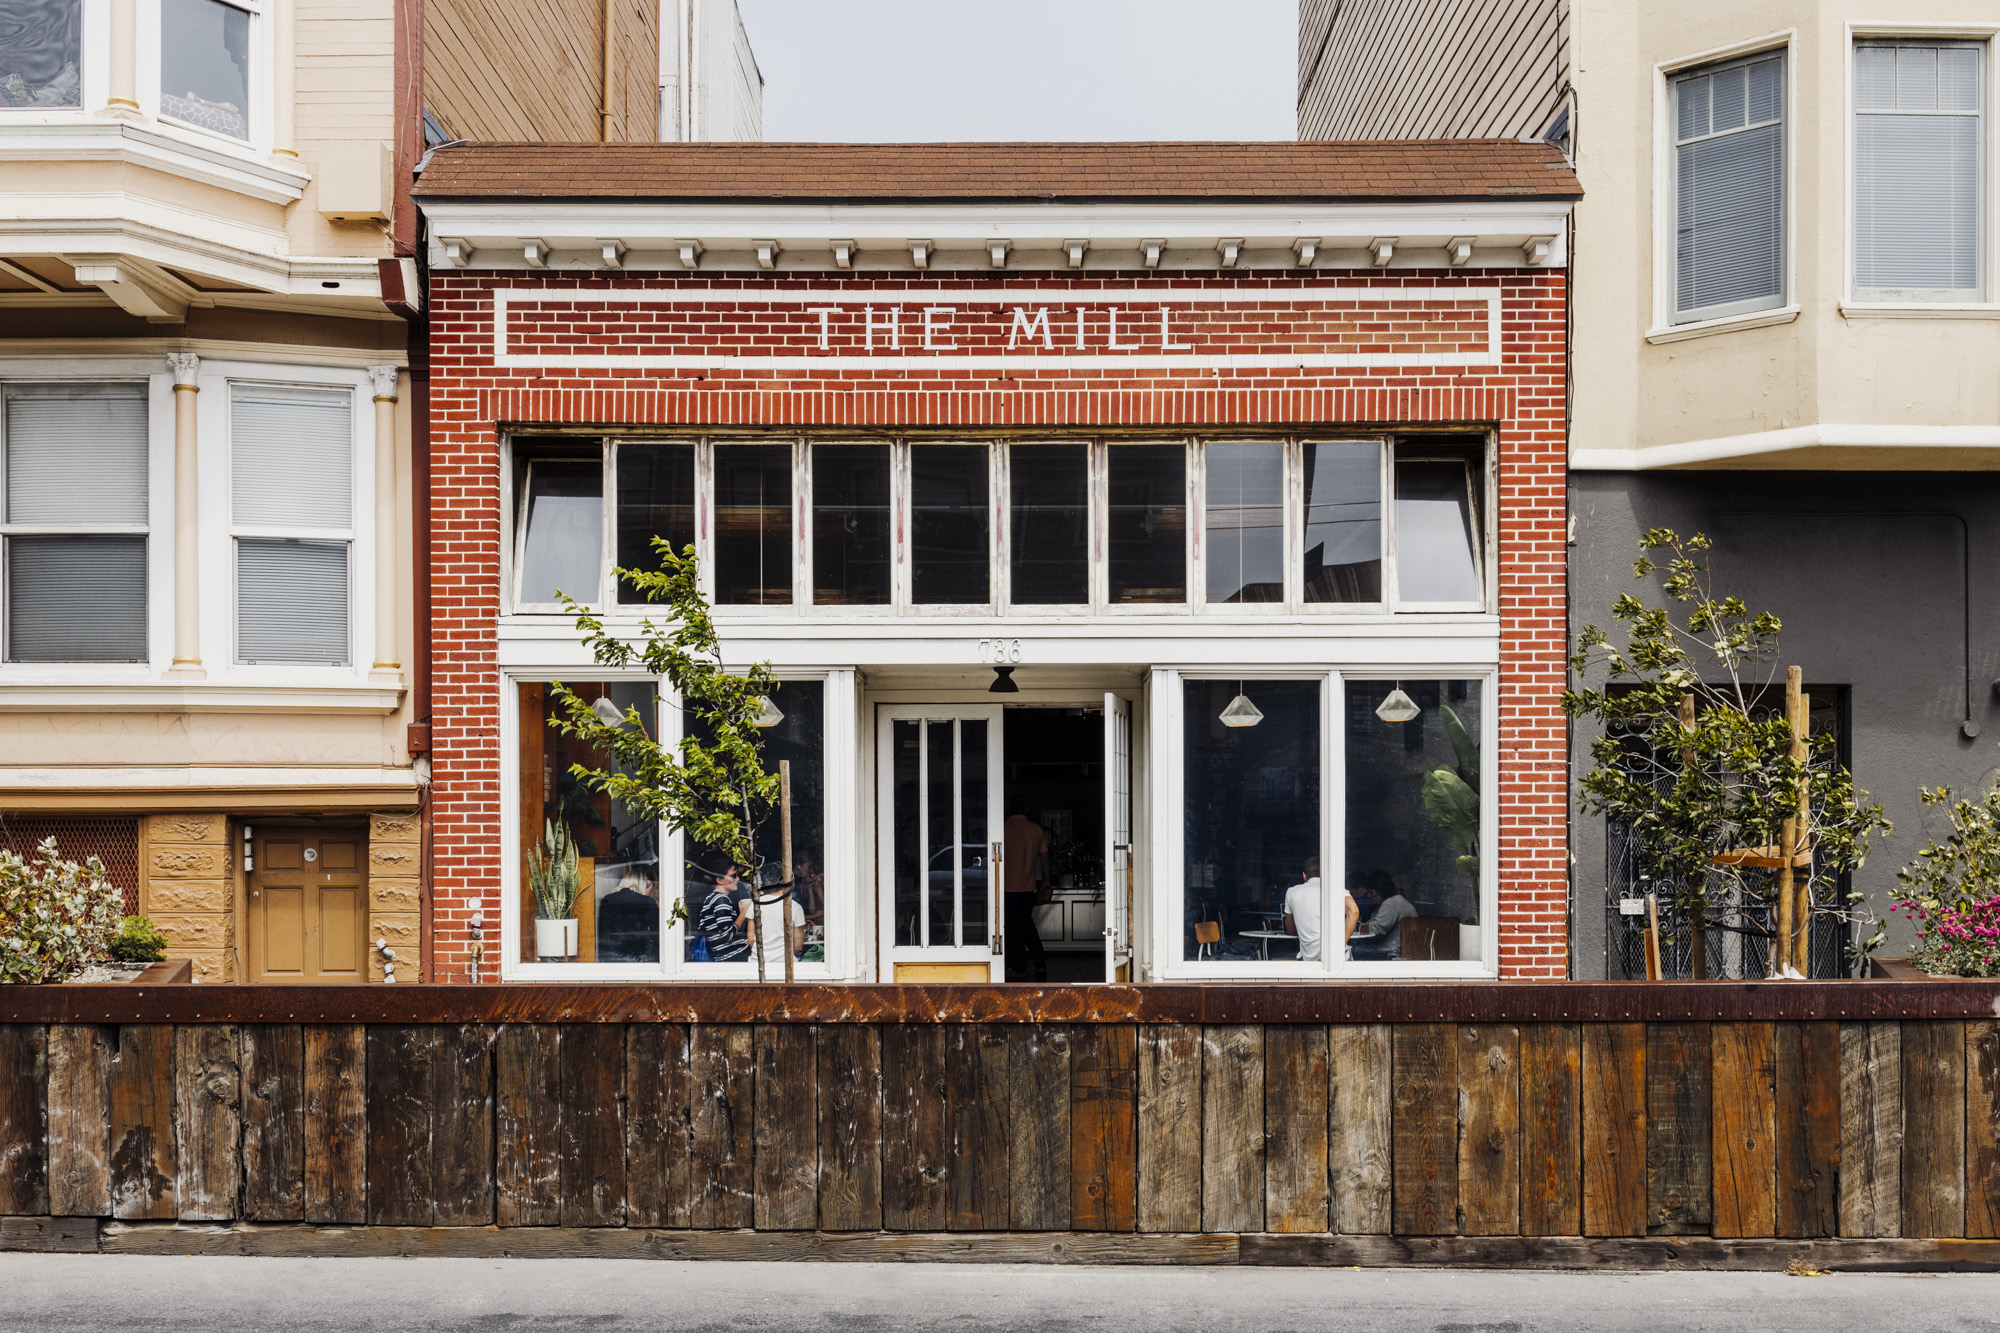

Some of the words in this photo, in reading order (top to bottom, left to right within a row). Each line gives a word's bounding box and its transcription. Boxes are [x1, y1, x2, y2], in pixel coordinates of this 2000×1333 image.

[807, 307, 958, 350] THE
[1007, 307, 1191, 350] MILL
[979, 639, 1021, 663] 736
